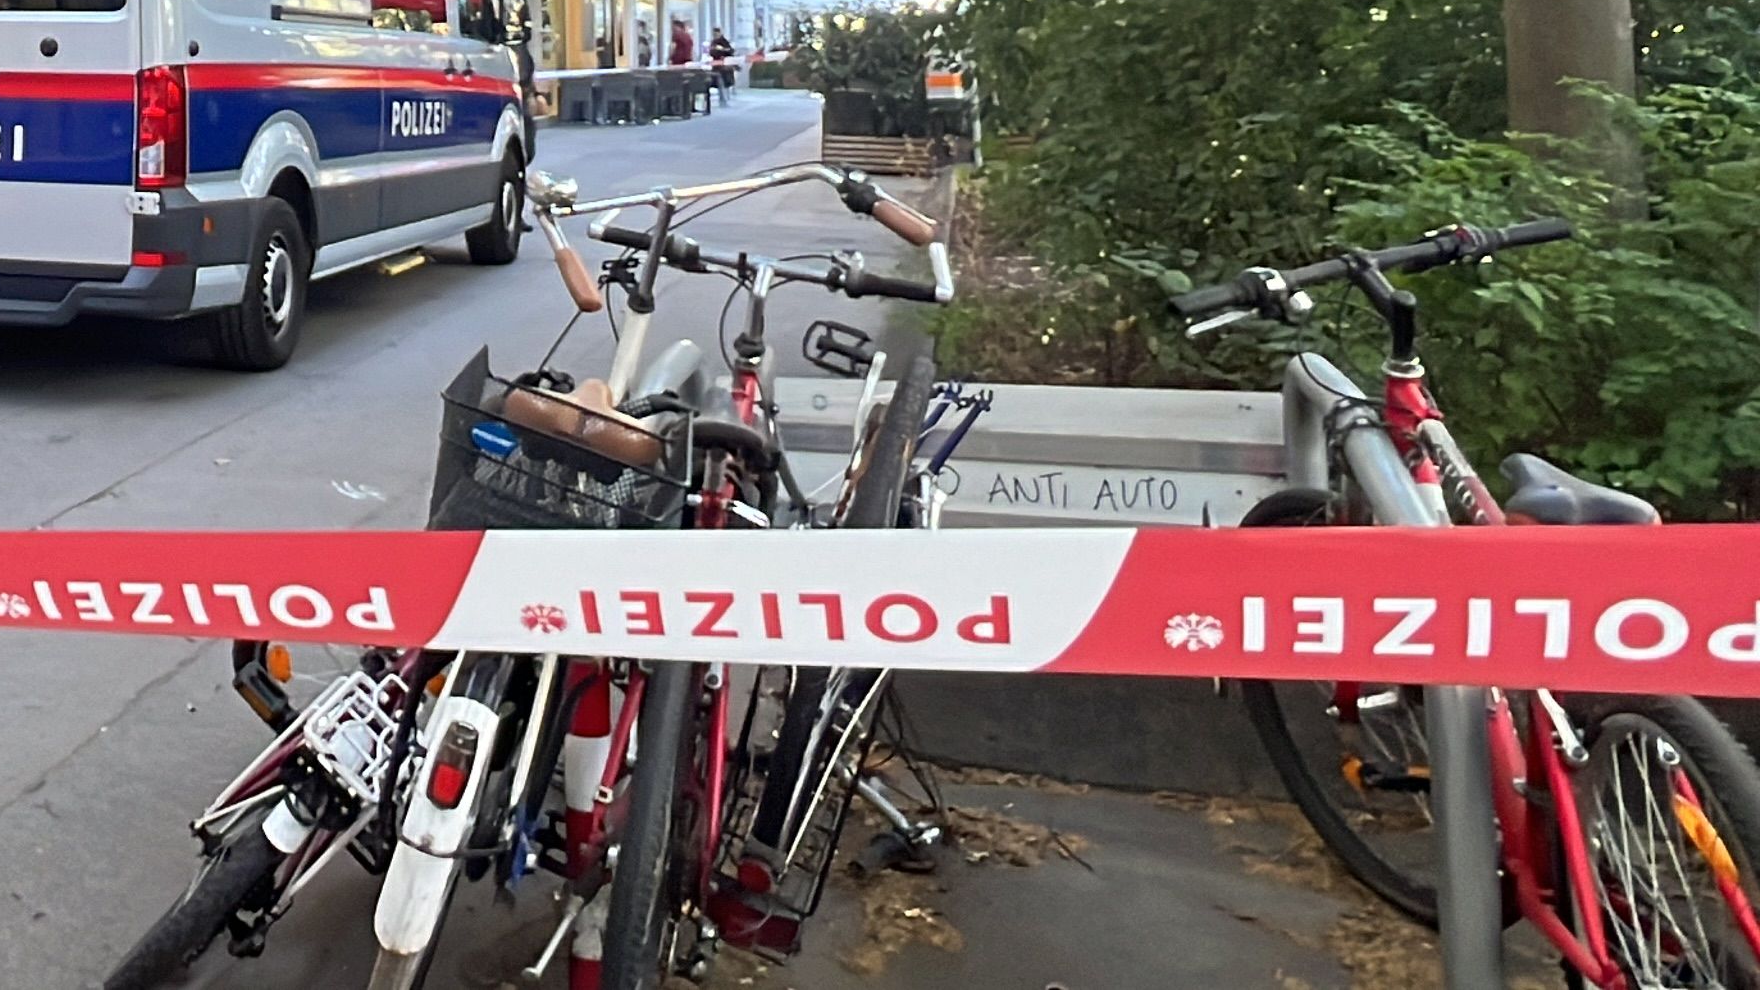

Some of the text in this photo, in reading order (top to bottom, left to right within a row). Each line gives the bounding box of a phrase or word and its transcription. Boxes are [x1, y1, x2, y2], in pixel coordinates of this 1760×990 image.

[391, 100, 446, 137] POLIZEI
[989, 471, 1068, 509] ANTI
[1093, 476, 1179, 512] AUTO
[30, 579, 397, 631] POLIZEI
[578, 589, 1012, 645] POLIZEI
